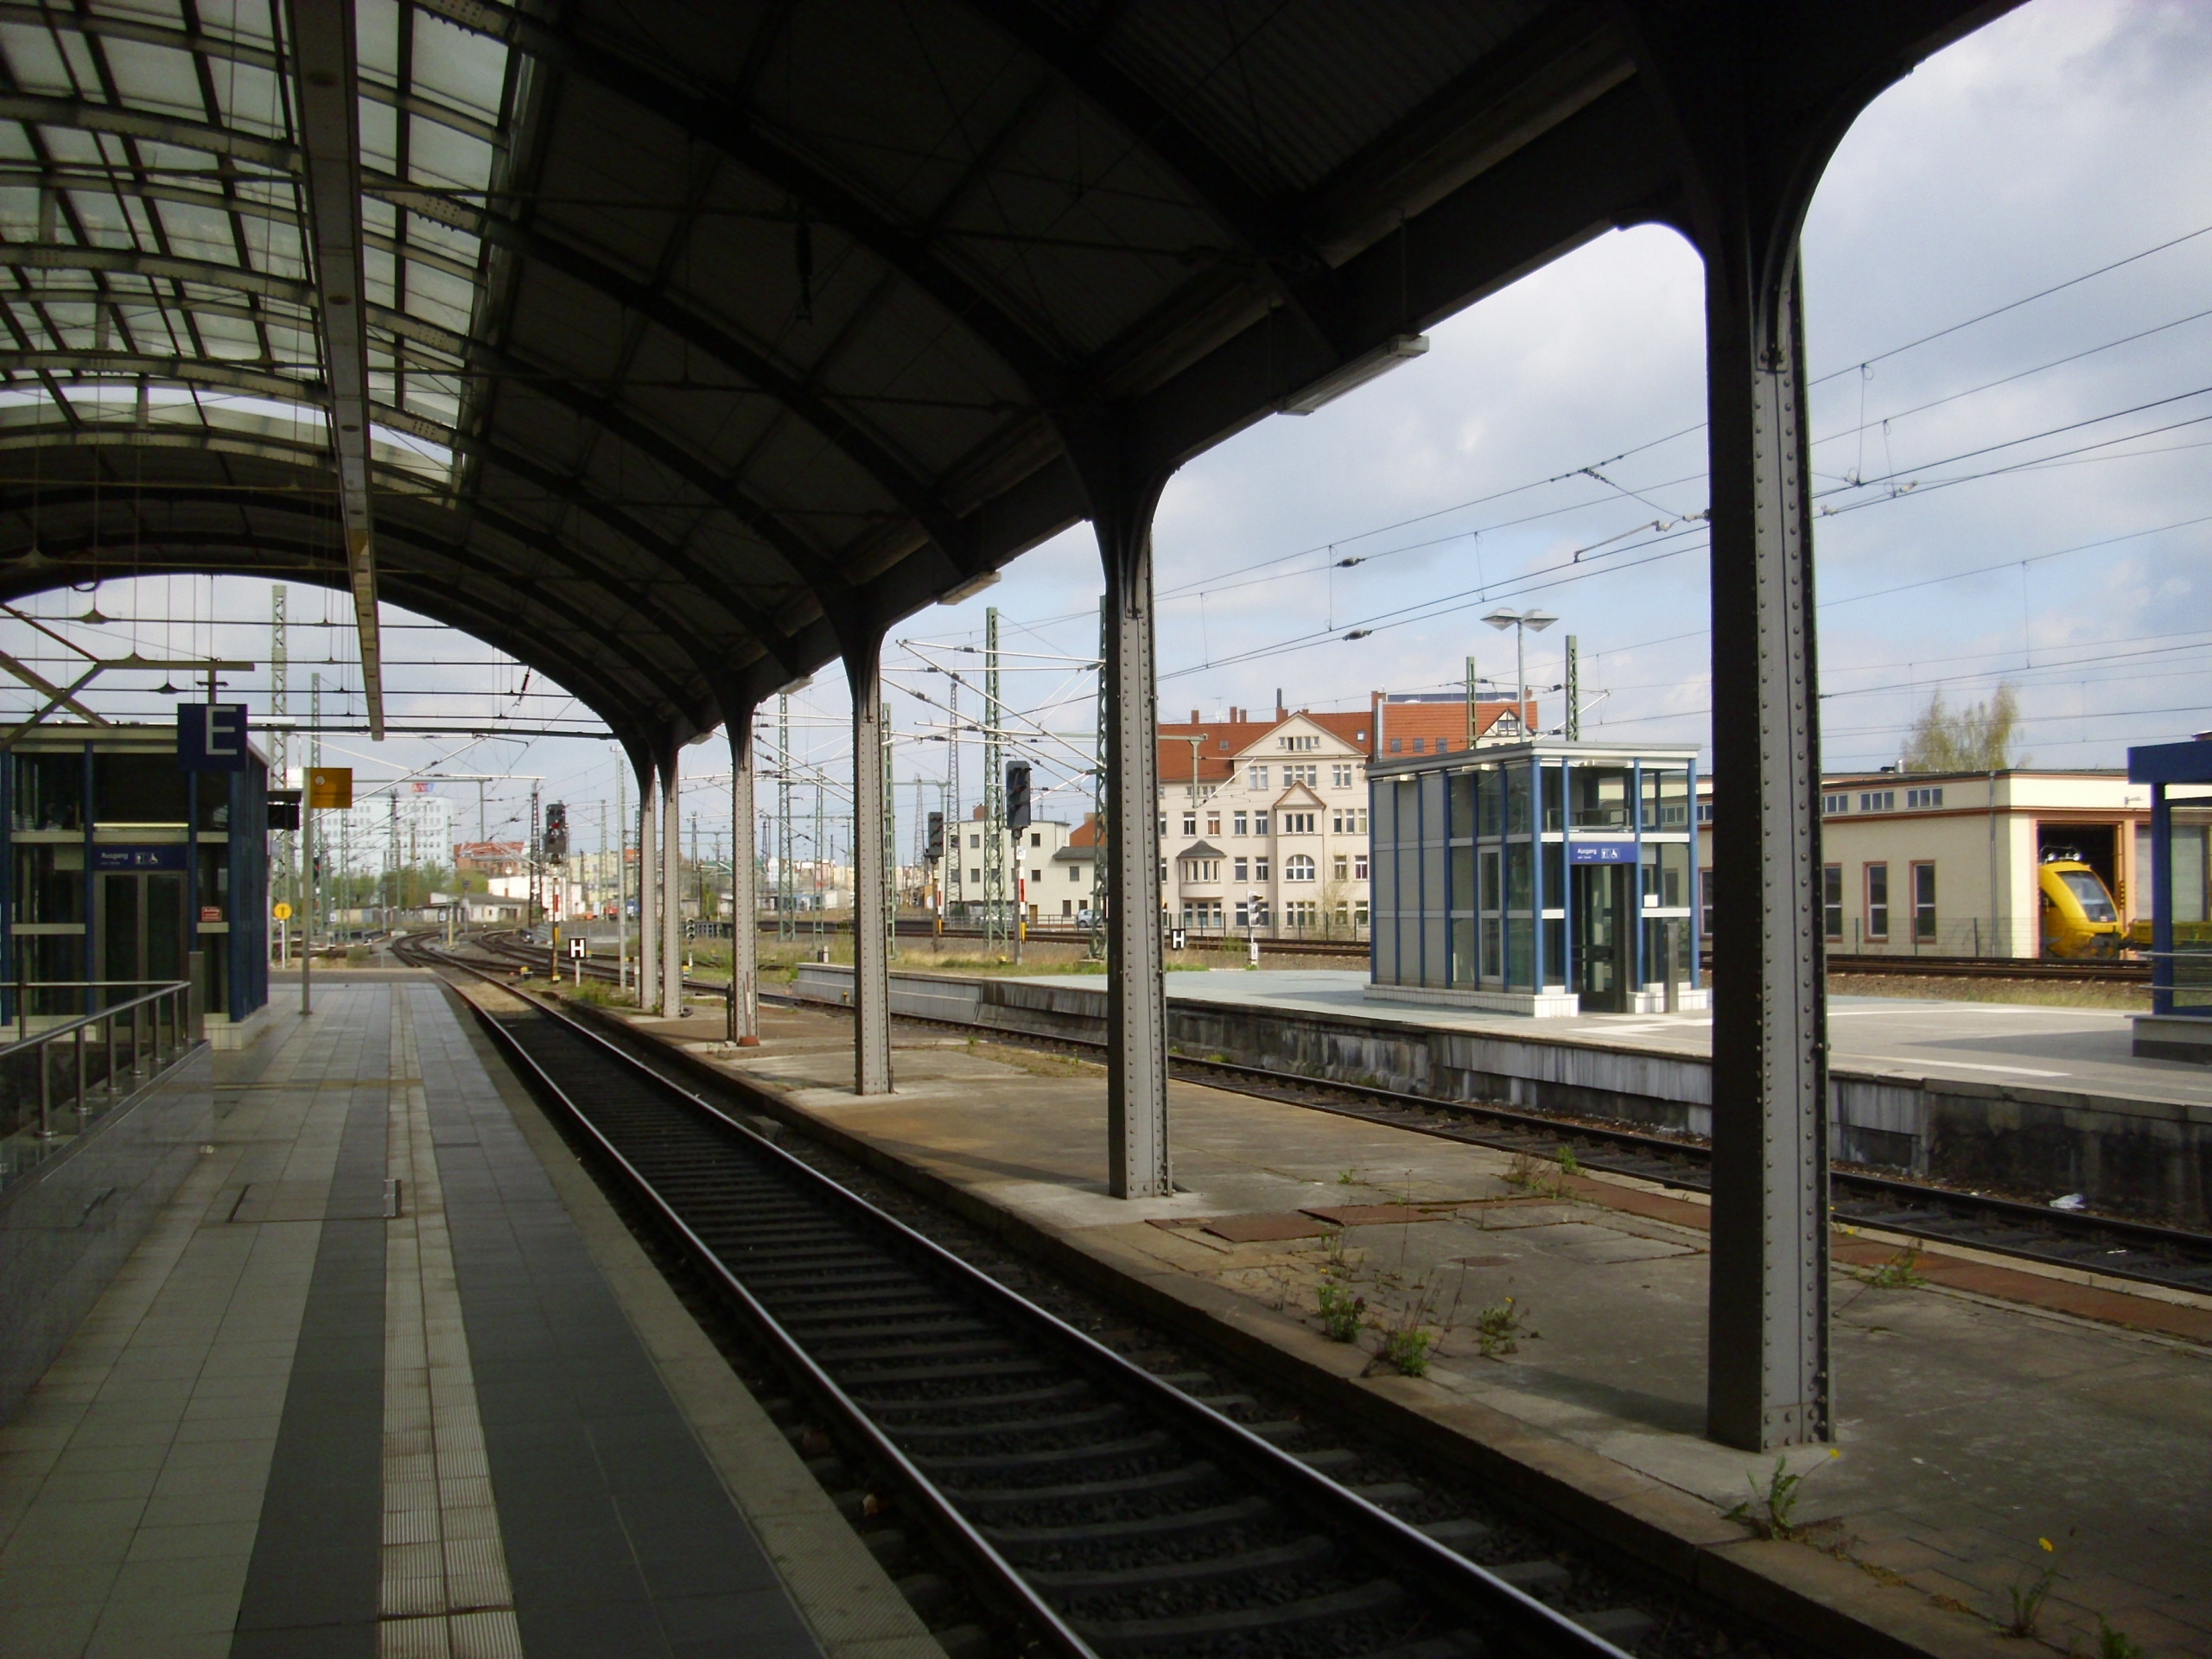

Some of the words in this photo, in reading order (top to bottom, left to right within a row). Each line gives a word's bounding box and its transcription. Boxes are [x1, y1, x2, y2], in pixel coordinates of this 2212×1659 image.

[206, 705, 237, 755] E
[101, 852, 129, 861] Ausgang
[570, 939, 585, 958] H
[1173, 931, 1185, 949] H
